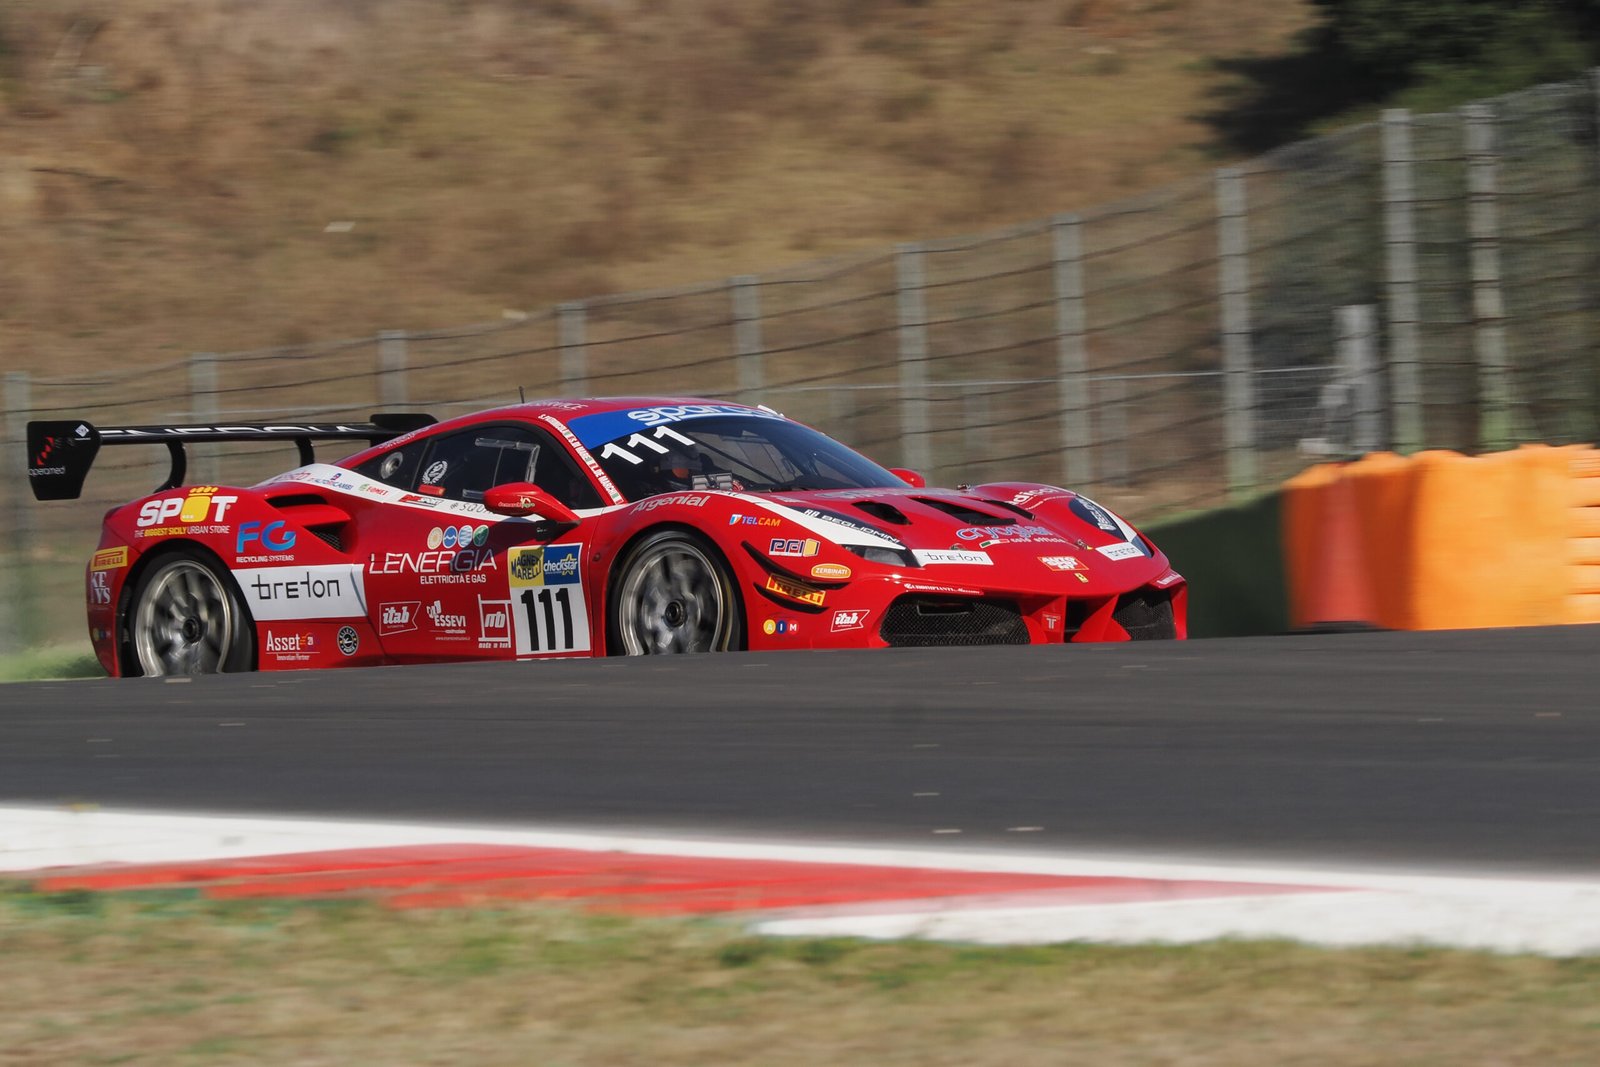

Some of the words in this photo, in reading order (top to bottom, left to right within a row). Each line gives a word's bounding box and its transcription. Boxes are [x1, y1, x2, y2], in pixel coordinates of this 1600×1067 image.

[601, 426, 696, 465] 111
[187, 526, 209, 534] URBAN
[209, 525, 231, 534] STORE
[94, 551, 124, 567] PIRELLI
[369, 549, 498, 575] LENERGIA
[544, 559, 578, 573] checkstar
[465, 574, 471, 584] E
[471, 574, 487, 584] GAS
[768, 580, 825, 605] PIRELLI
[383, 606, 410, 625] itab
[435, 614, 467, 627] ESSEVI
[520, 588, 575, 651] 111
[267, 630, 301, 652] Asset
